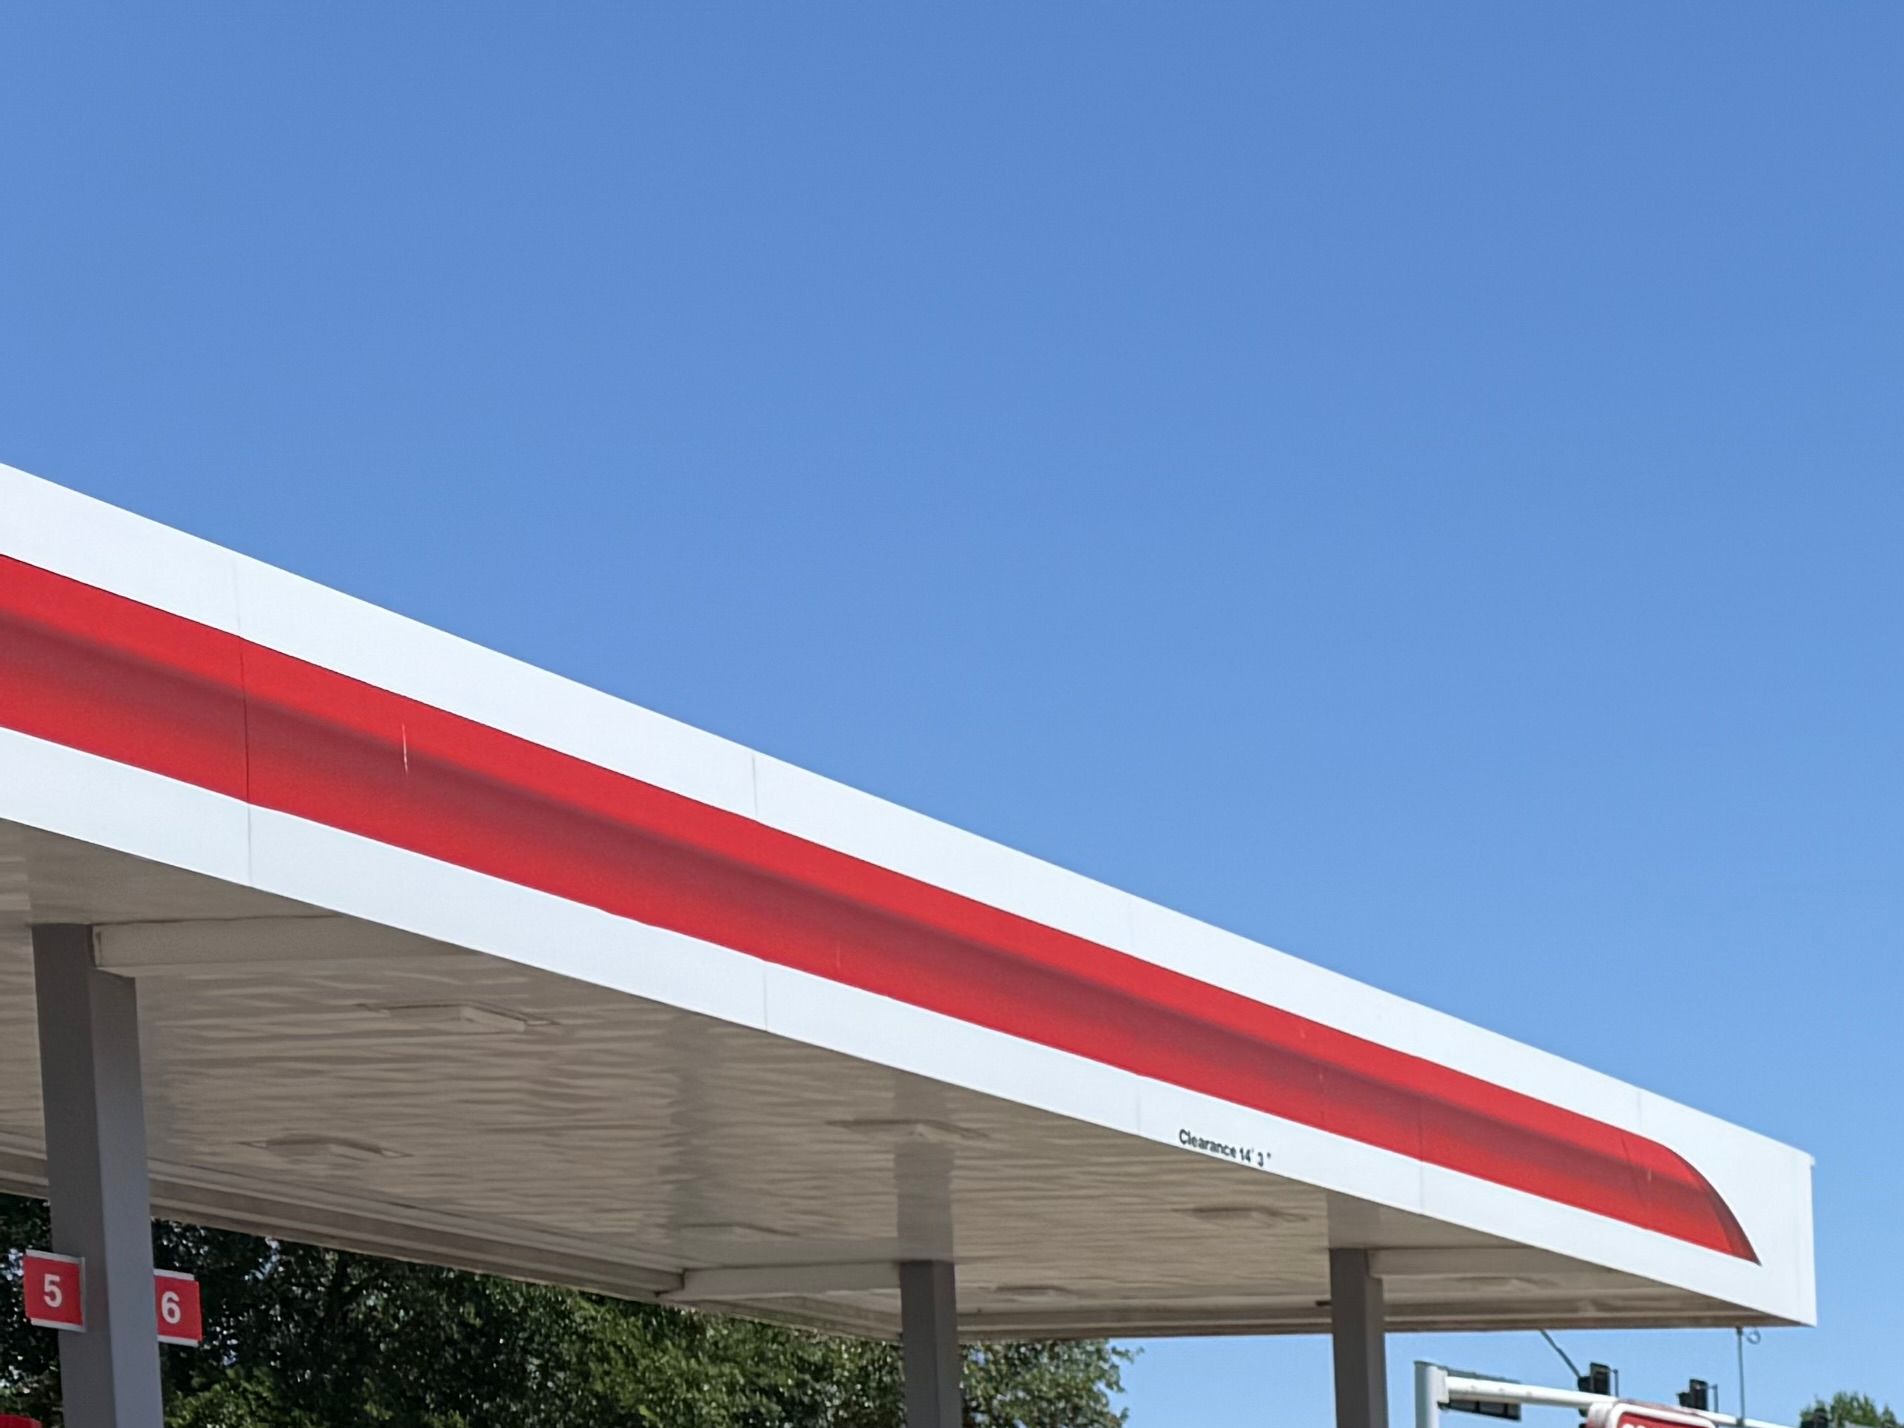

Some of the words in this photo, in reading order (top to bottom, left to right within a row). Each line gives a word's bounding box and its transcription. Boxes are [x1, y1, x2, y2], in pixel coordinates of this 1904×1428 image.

[1178, 1128, 1237, 1159] Clearance
[43, 1273, 63, 1309] 5
[160, 1291, 182, 1325] 6
